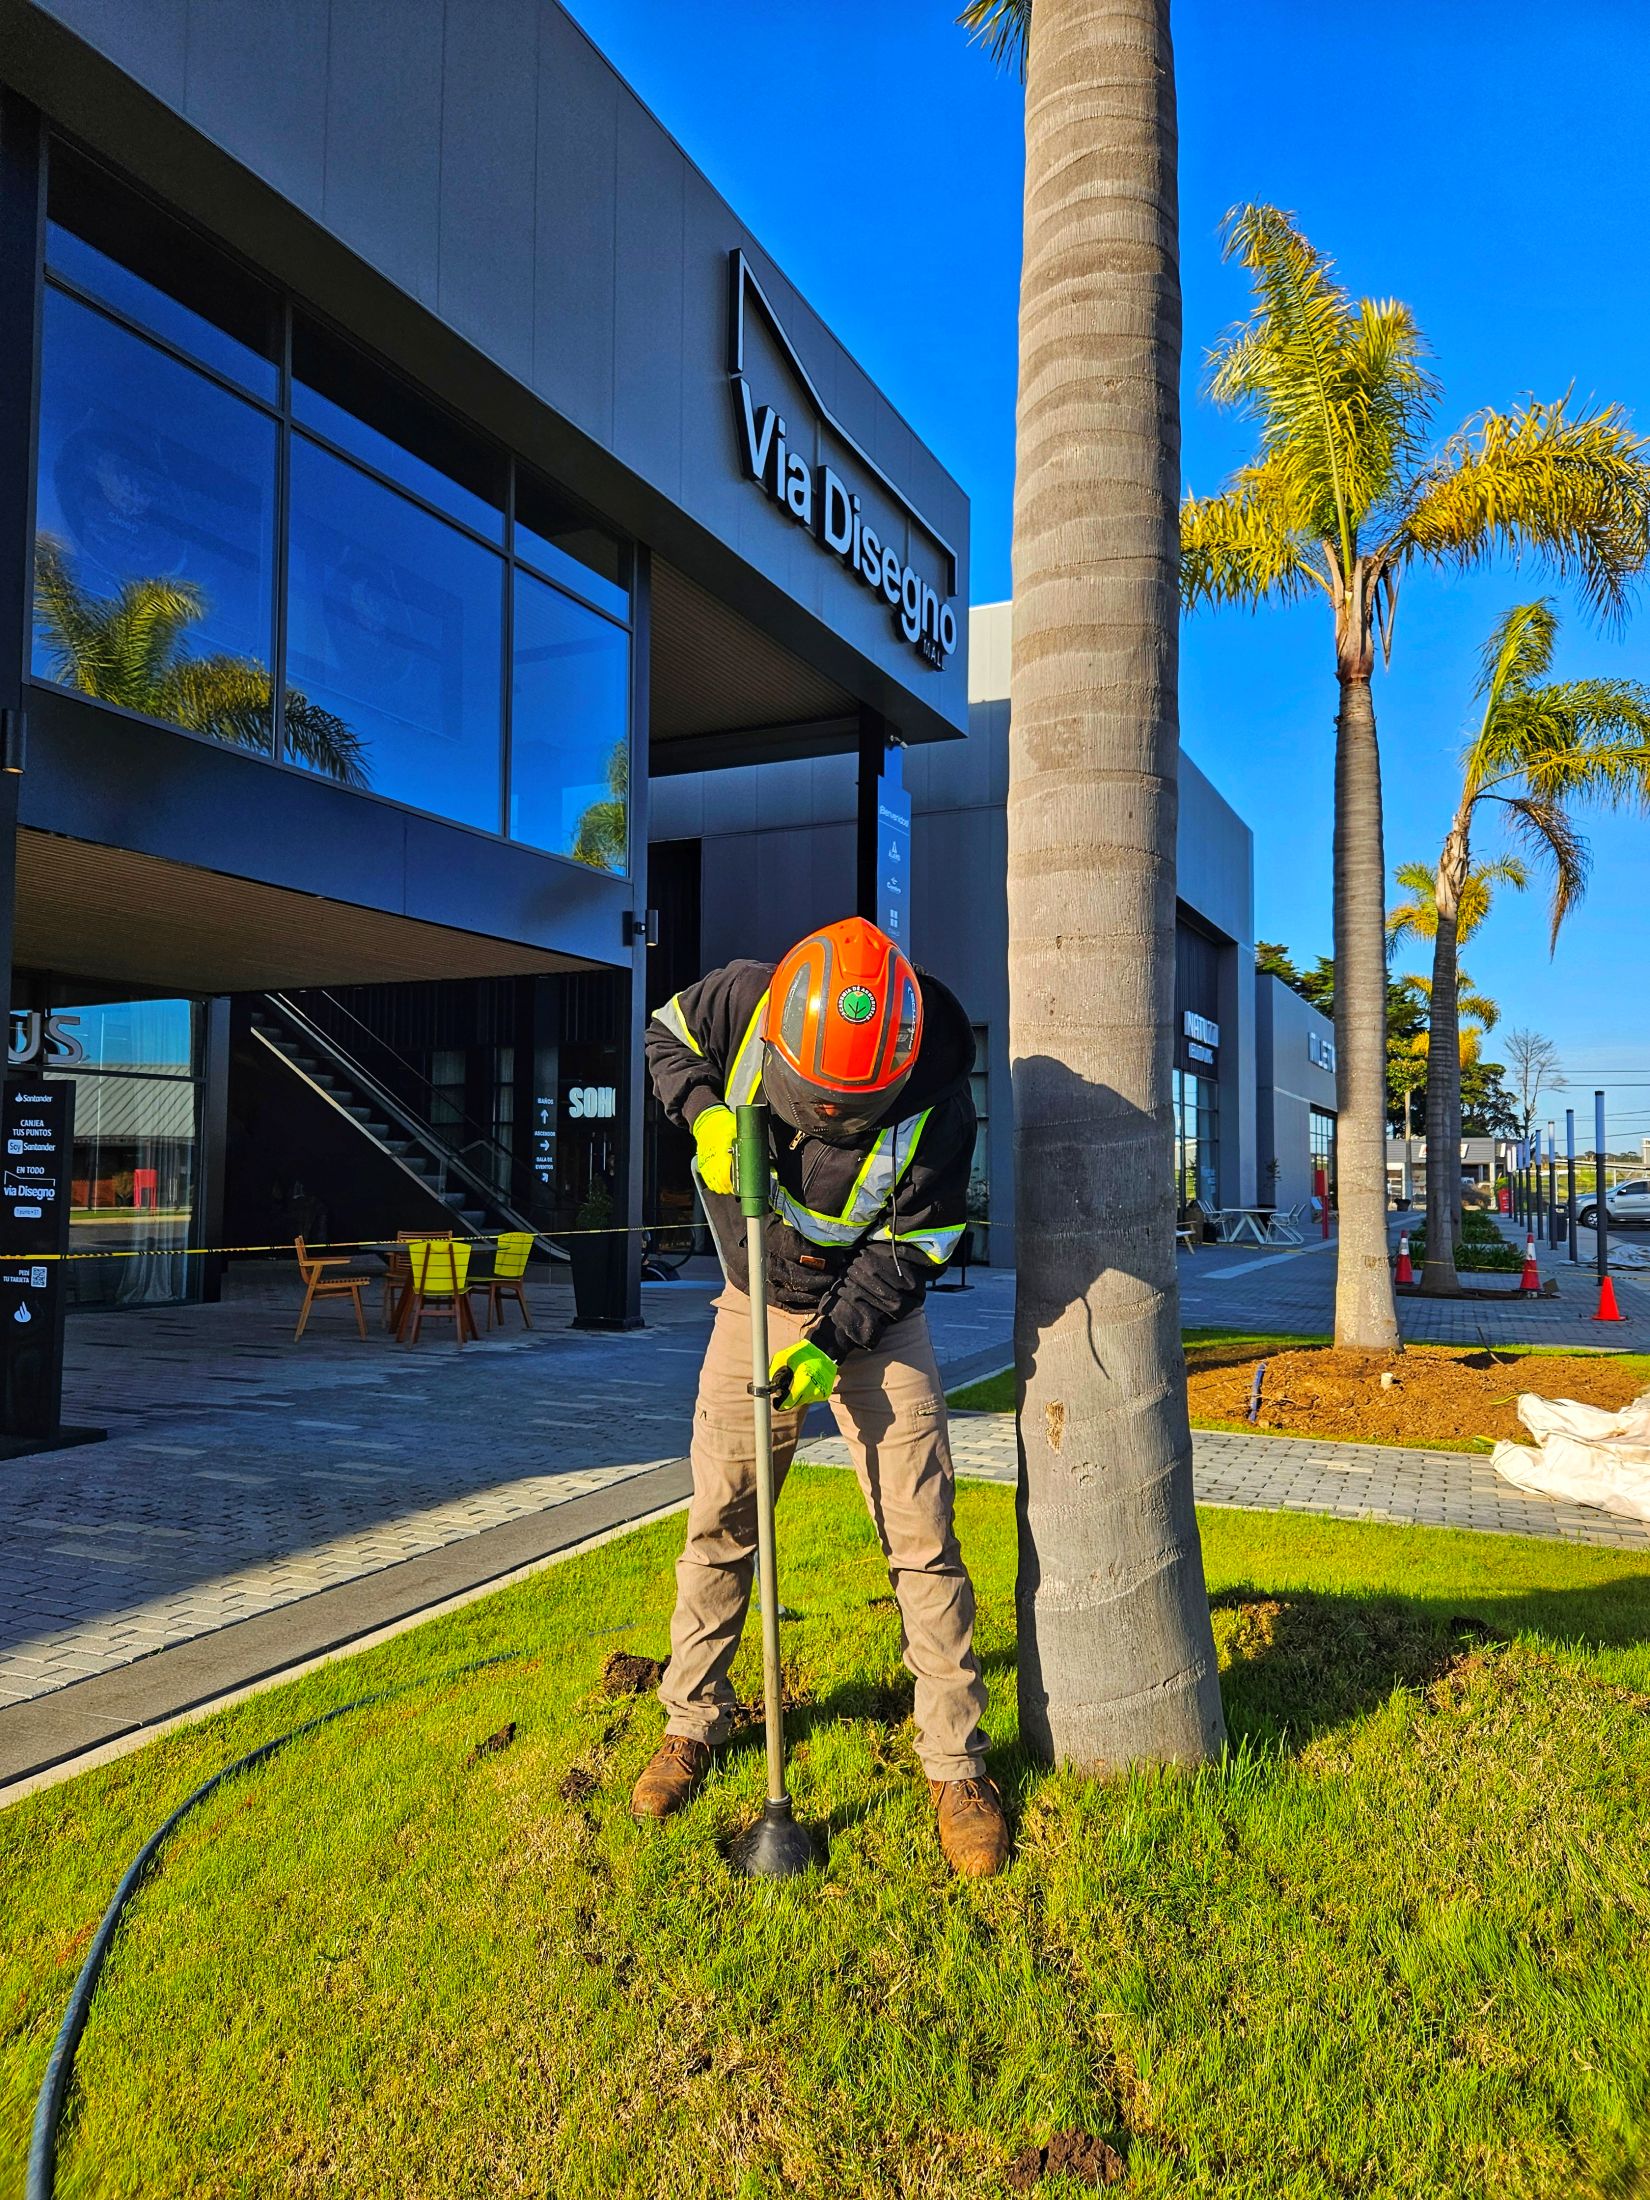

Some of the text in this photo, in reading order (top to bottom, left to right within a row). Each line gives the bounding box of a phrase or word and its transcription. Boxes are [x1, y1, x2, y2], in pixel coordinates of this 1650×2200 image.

[825, 465, 957, 655] Disegno
[22, 1094, 53, 1103] Santander
[537, 1097, 554, 1105] BAÑOS
[568, 1086, 616, 1118] SOH
[20, 1119, 44, 1127] CANJEA
[13, 1128, 52, 1137] TUS PUNTOS
[23, 1142, 56, 1151] Santander
[16, 1166, 45, 1175] EN TODO
[18, 1185, 56, 1200] Disegno
